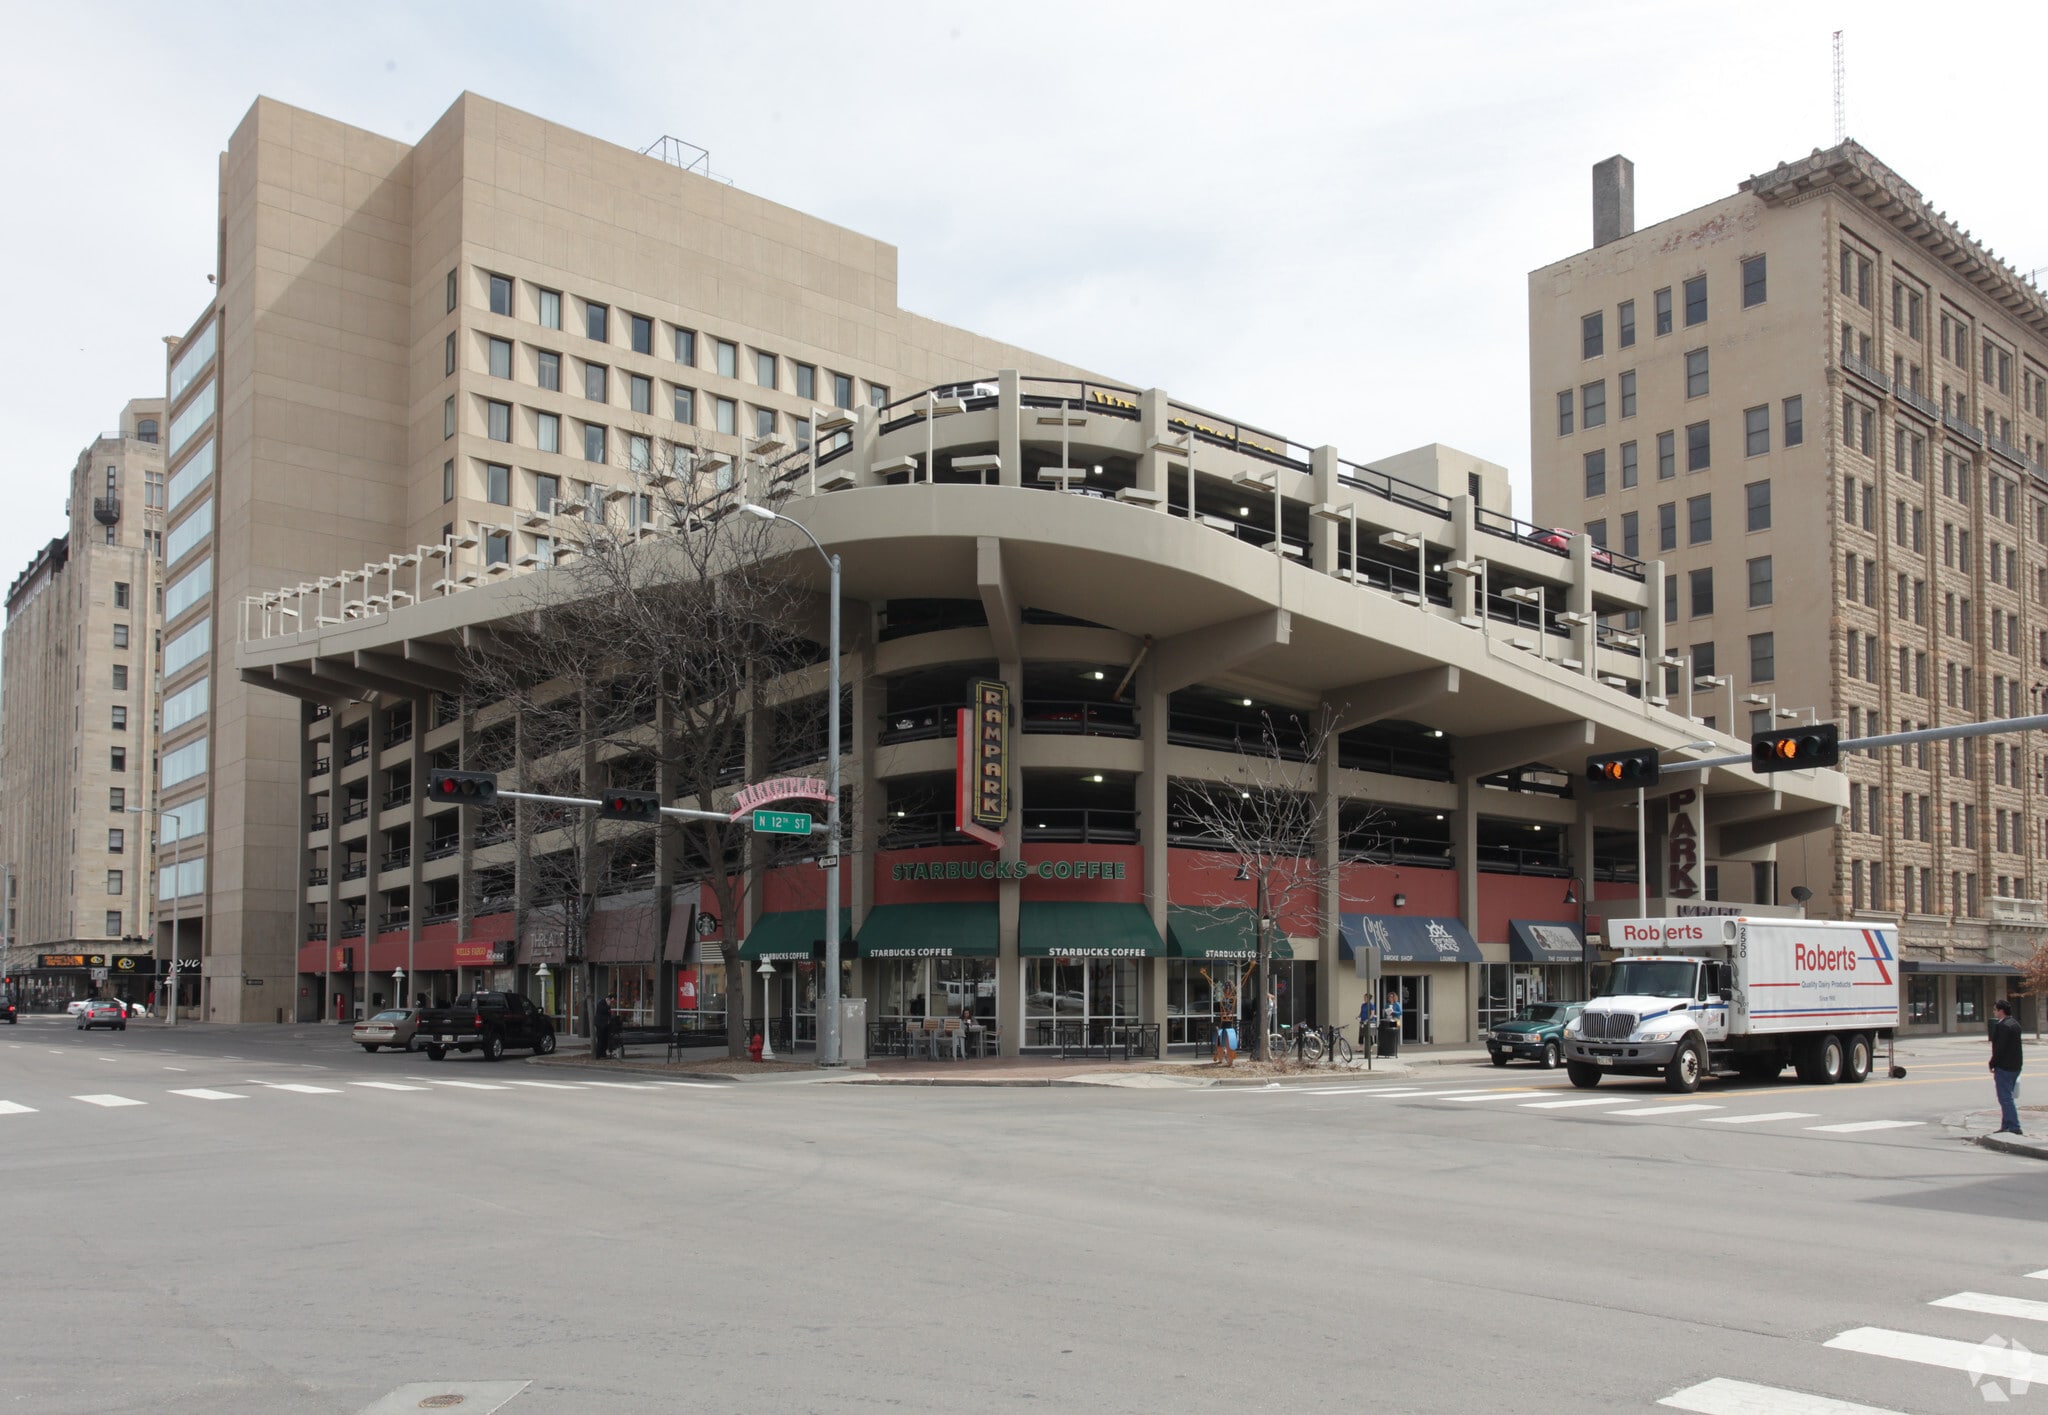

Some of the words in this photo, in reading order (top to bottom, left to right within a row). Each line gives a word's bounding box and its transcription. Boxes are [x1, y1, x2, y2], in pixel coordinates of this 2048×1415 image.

[983, 690, 1002, 813] RAMPARK
[759, 815, 766, 827] N
[794, 818, 805, 829] ST
[1669, 788, 1698, 889] PARK
[891, 861, 1028, 881] STARBUCKS
[1037, 861, 1126, 880] COFFEE
[1739, 927, 1747, 958] 2550
[789, 952, 809, 960] COFFEE
[870, 949, 916, 957] STARBUCKS
[917, 948, 953, 956] COFFEE
[1049, 948, 1110, 957] STARBUCKS
[1111, 948, 1146, 957] COFFEE
[1205, 950, 1247, 959] STARBUCKS
[1795, 943, 1857, 972] Roberts
